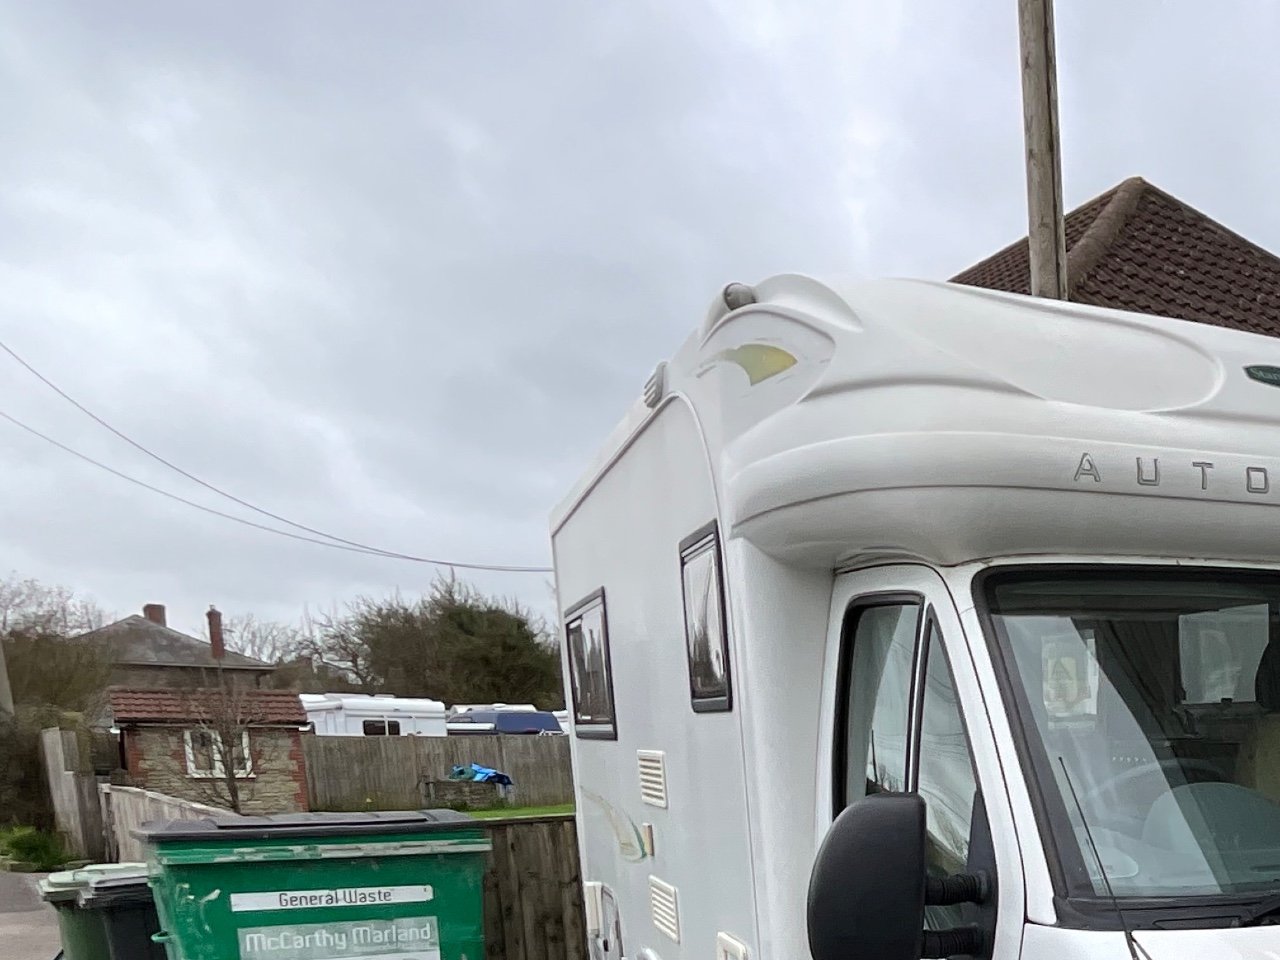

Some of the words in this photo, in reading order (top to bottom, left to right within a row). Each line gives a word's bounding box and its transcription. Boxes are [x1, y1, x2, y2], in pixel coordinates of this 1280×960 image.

[279, 890, 339, 907] General
[344, 888, 392, 904] Waste
[245, 928, 346, 952] McCarthy
[352, 922, 431, 945] Marland
